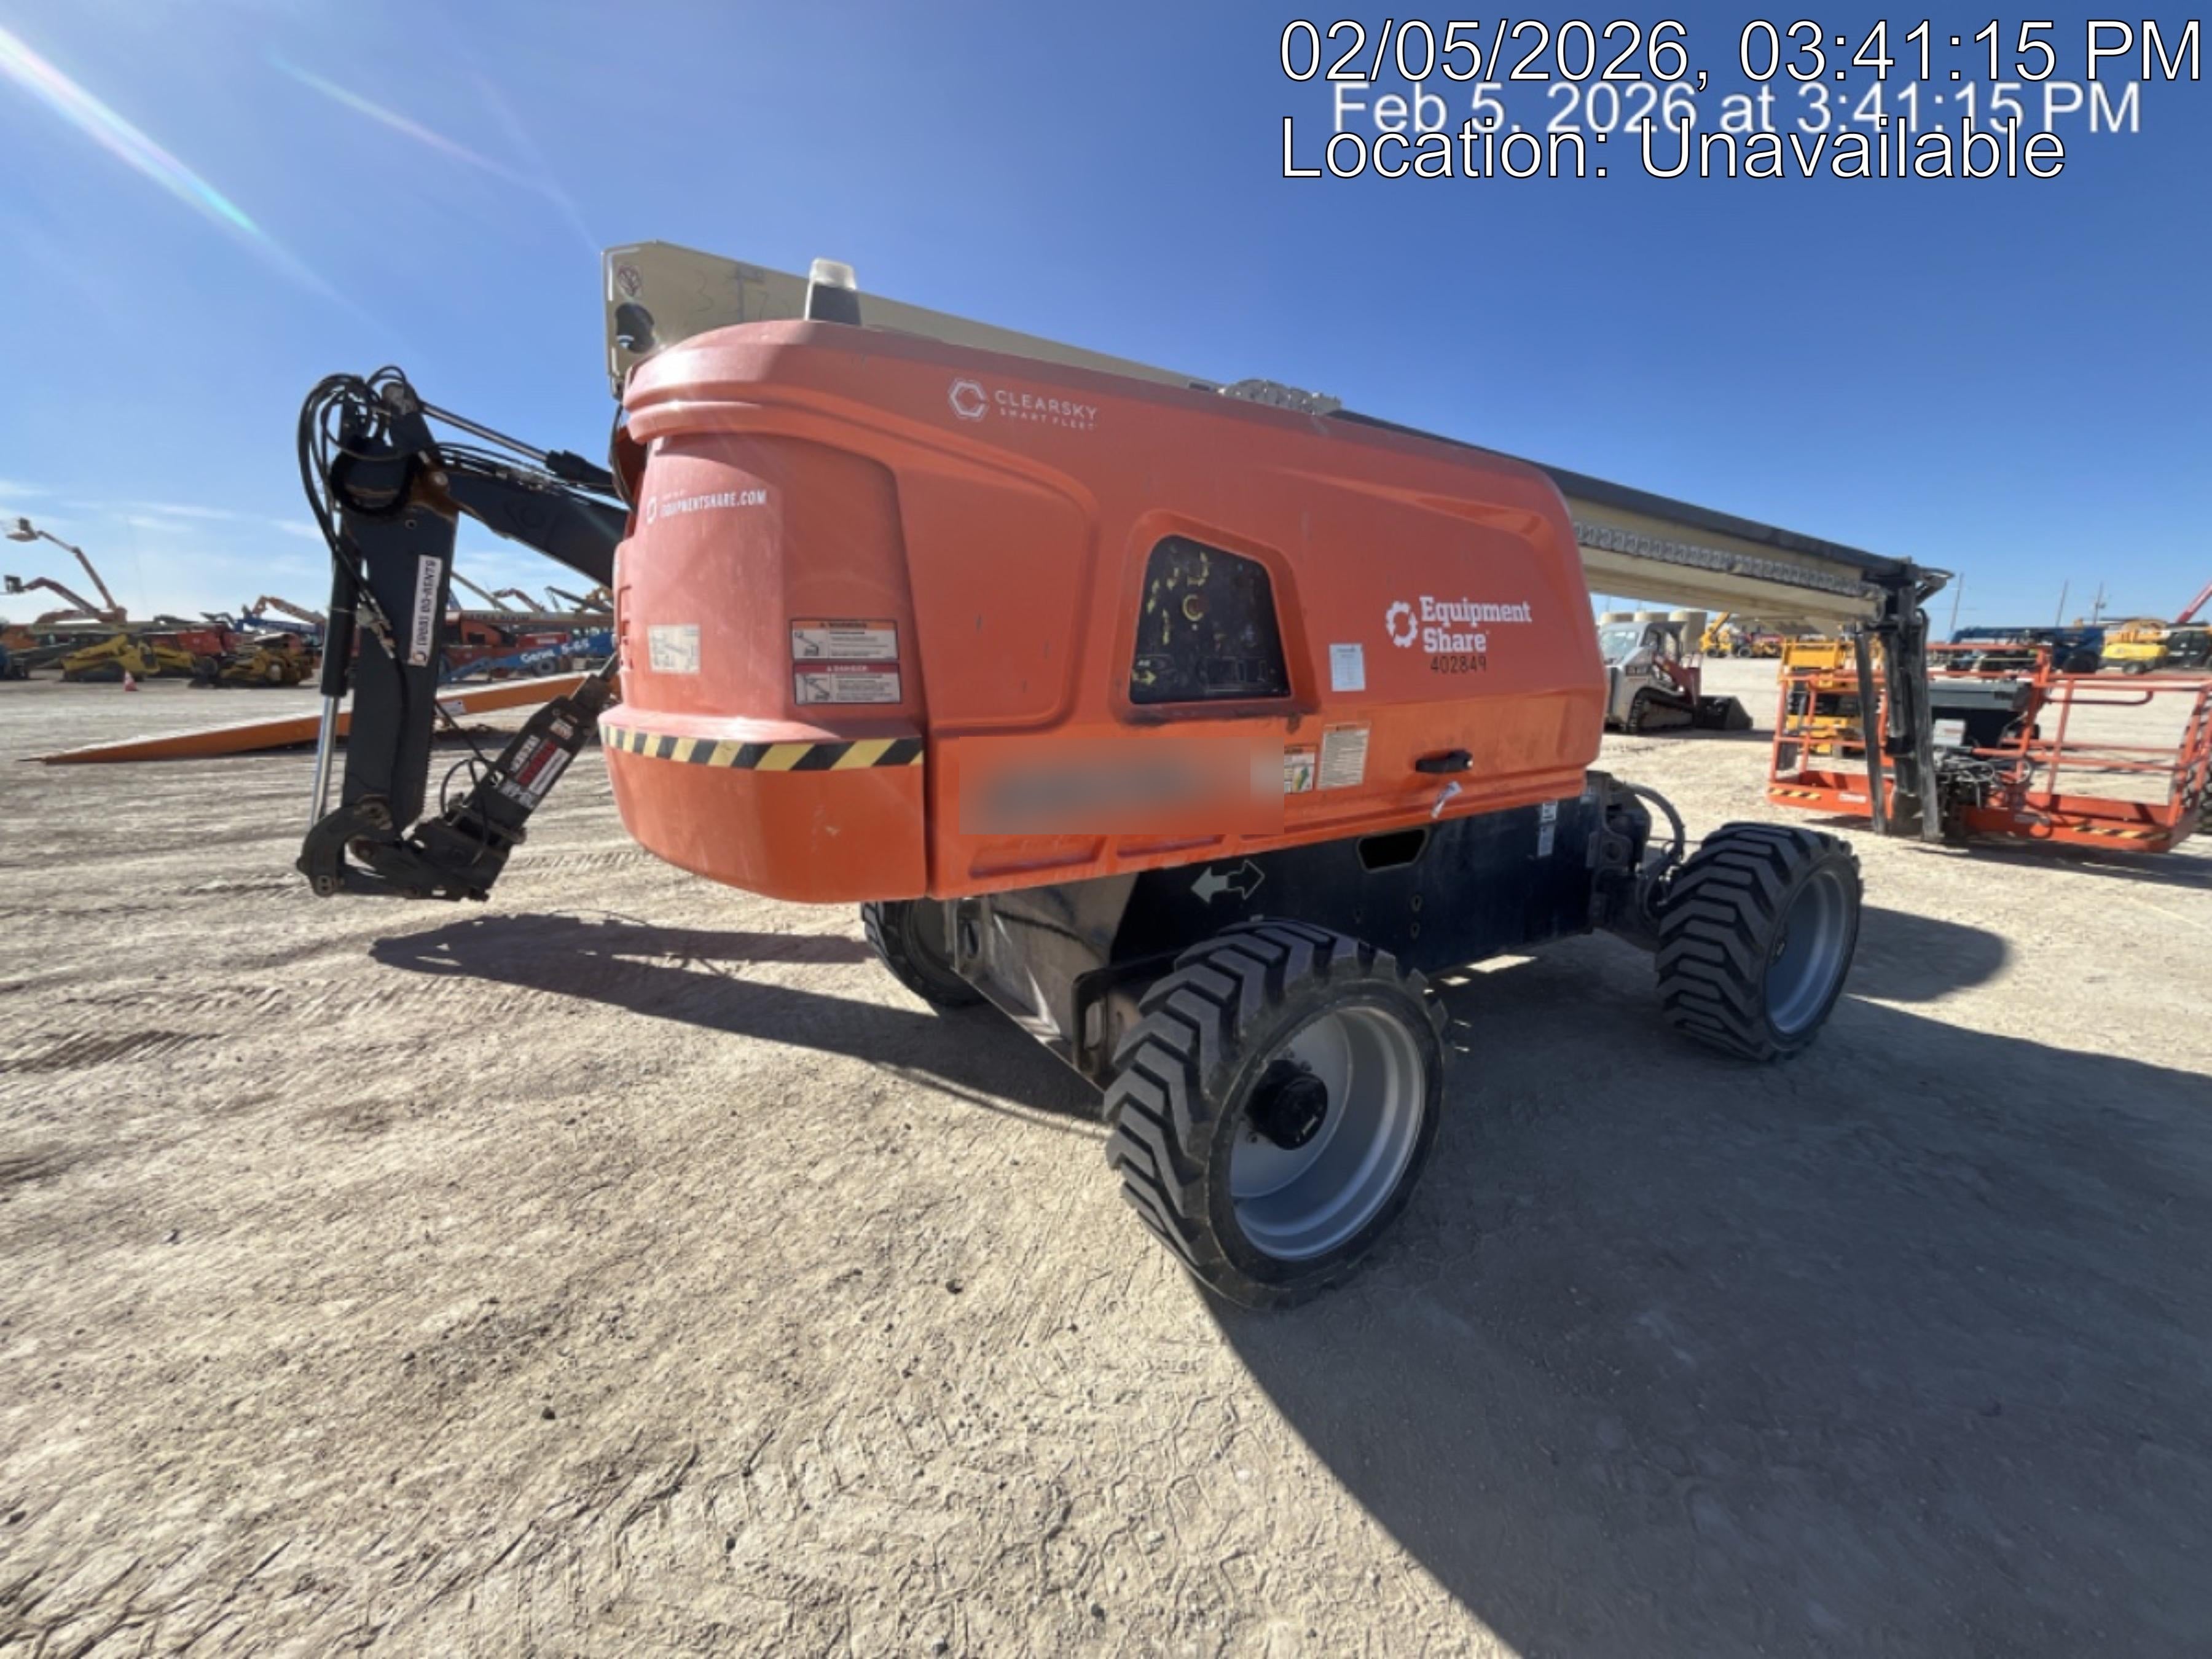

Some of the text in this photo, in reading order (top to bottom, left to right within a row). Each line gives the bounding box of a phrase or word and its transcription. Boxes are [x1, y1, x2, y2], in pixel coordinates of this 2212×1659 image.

[995, 390, 1097, 420] CLEARSKY
[1419, 595, 1532, 628] Equipment
[1423, 627, 1486, 653] Share
[1430, 655, 1487, 673] 402849
